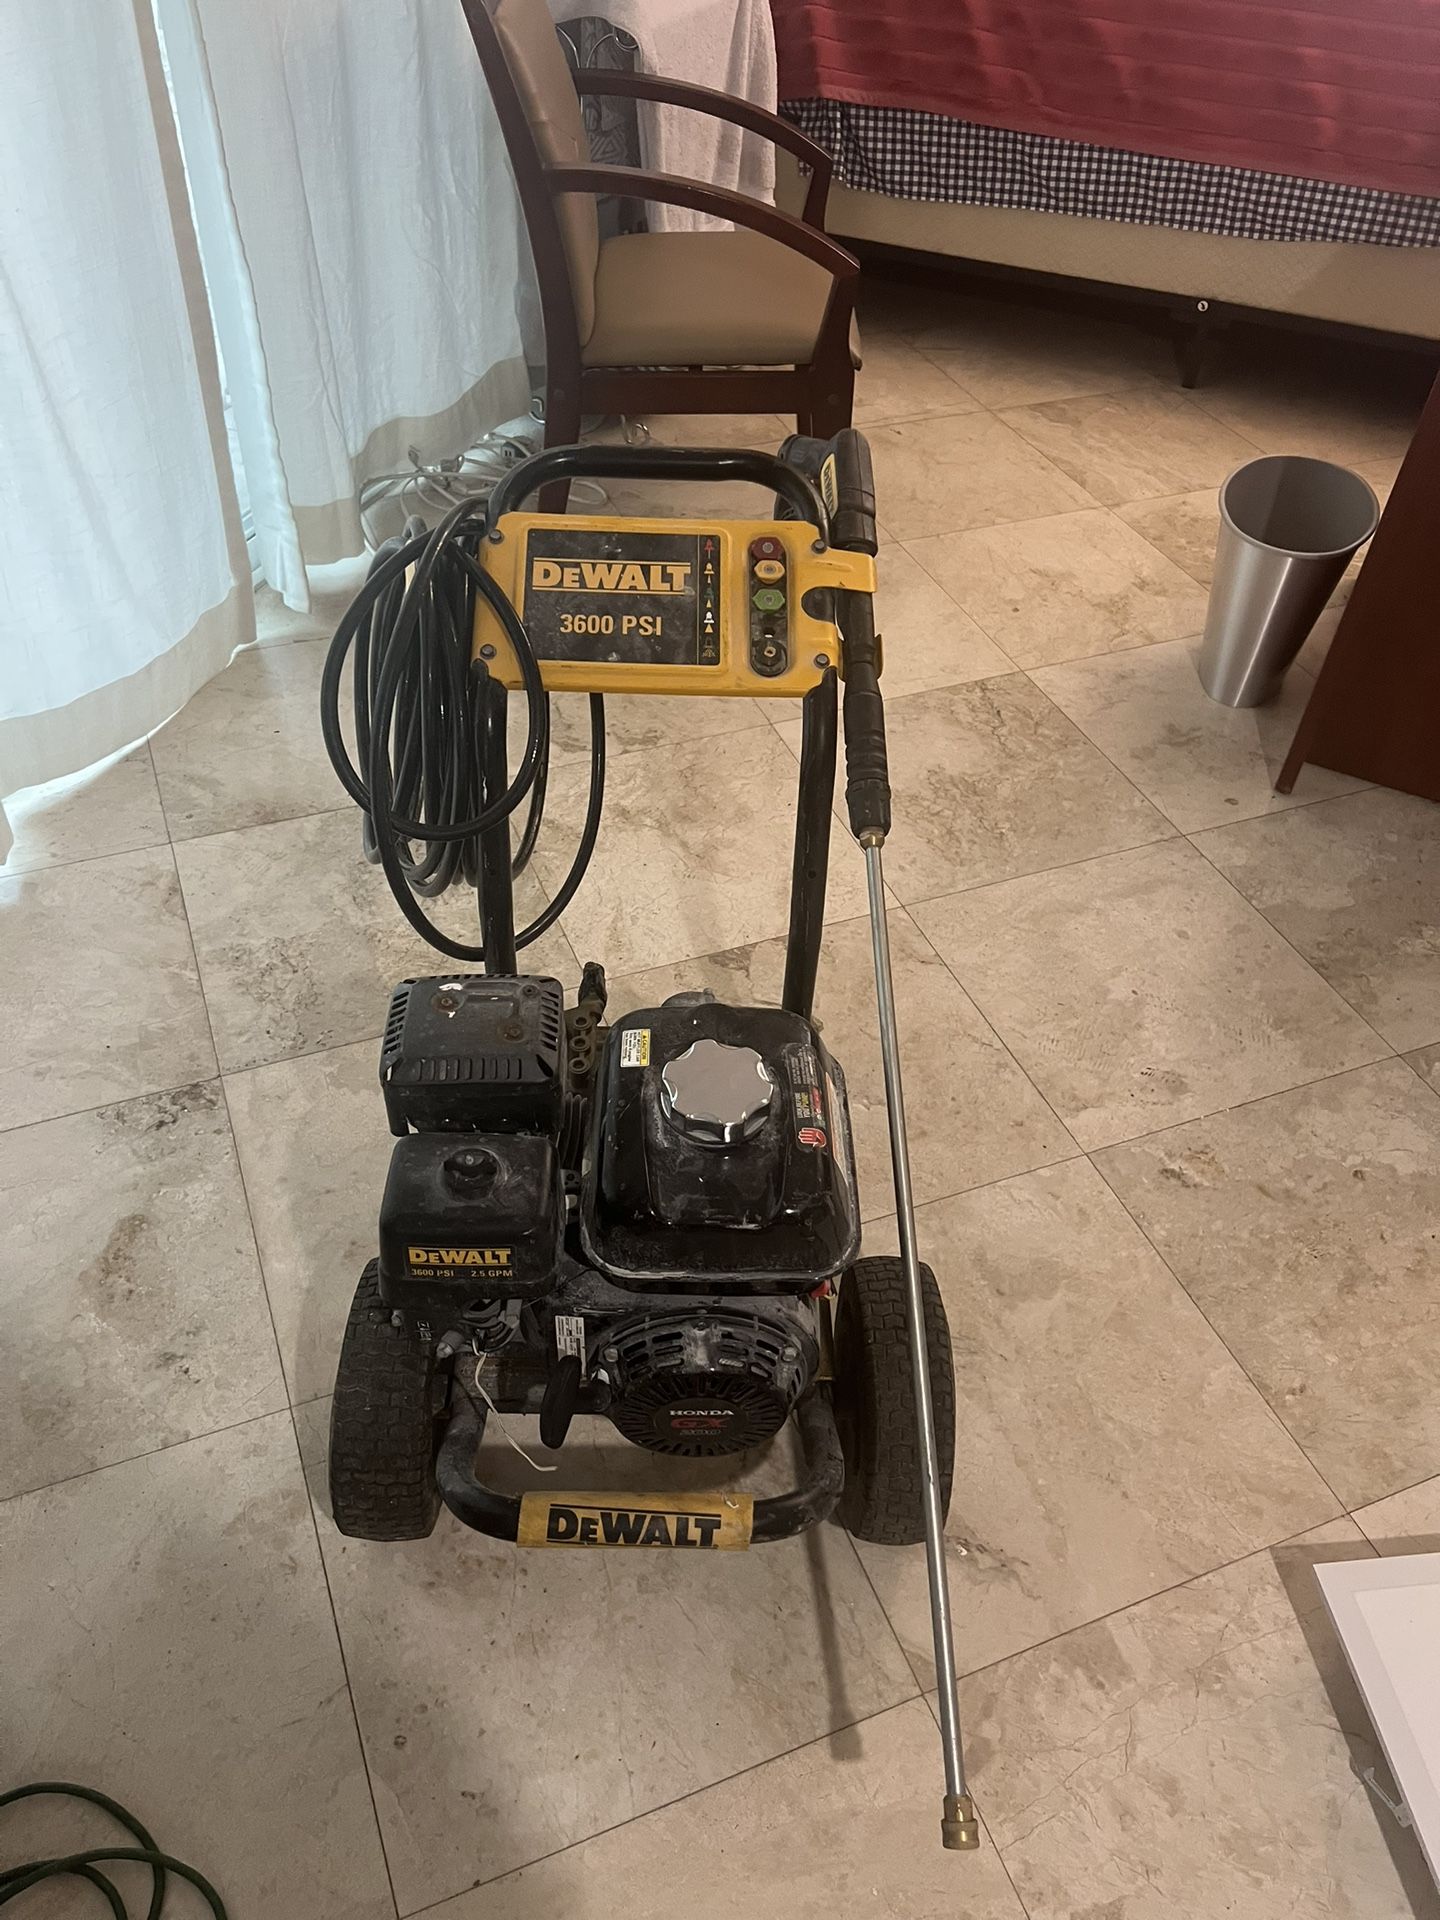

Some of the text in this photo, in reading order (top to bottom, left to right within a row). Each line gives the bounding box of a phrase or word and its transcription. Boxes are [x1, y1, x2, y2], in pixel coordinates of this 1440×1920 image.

[559, 613, 662, 636] 3600 PSI
[411, 1268, 513, 1278] 3600 PSI 2.5 GPM
[669, 1409, 735, 1417] HONDA
